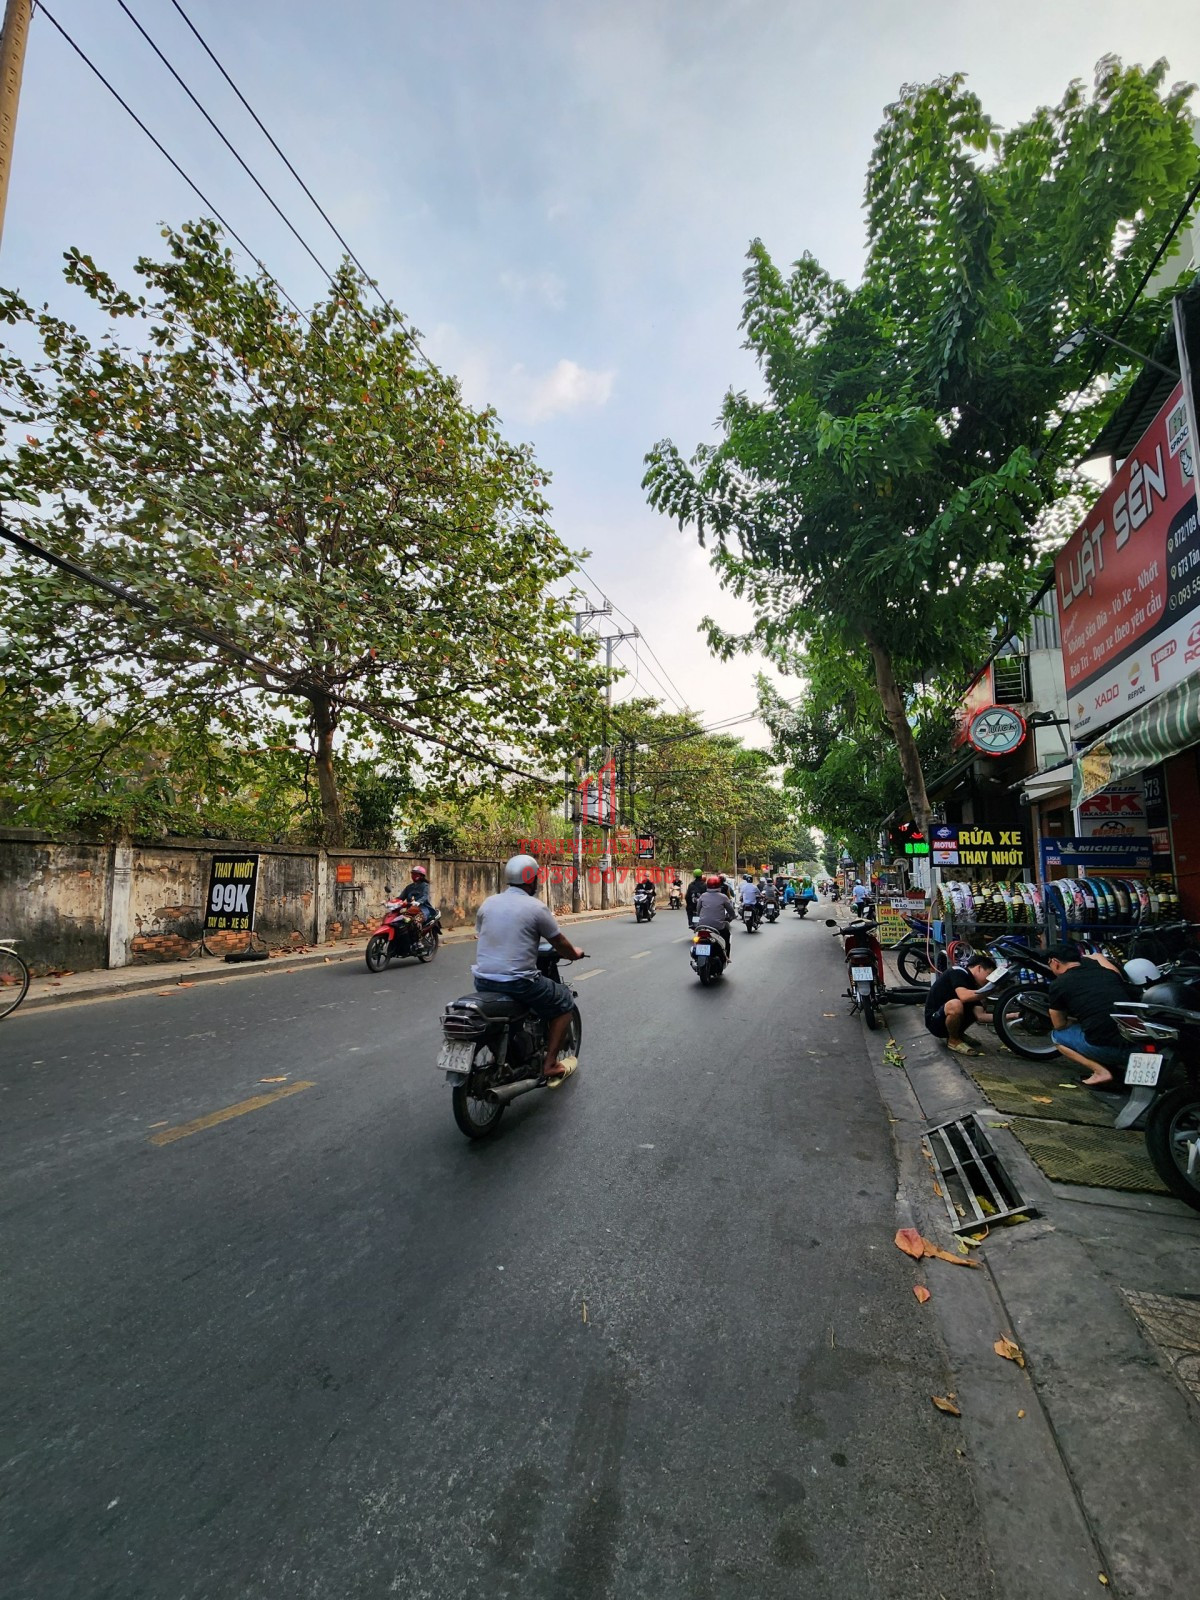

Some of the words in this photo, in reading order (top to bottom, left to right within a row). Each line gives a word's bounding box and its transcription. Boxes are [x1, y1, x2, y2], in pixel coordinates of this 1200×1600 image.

[1060, 519, 1105, 610] LUẬT
[1113, 444, 1167, 551] SÊN
[1178, 556, 1189, 578] 673
[1122, 589, 1132, 608] Xe
[1138, 560, 1158, 592] Nhớt
[1178, 585, 1191, 605] 093
[1106, 635, 1114, 649] xe
[1114, 621, 1129, 643] theo
[1131, 608, 1145, 635] yêu
[1146, 590, 1162, 617] cầu
[1094, 684, 1120, 709] XADO
[1081, 794, 1142, 812] RK
[933, 841, 957, 849] MOTUL
[959, 827, 994, 845] RỬA
[999, 831, 1022, 845] XE
[959, 851, 988, 864] THAY
[992, 848, 1023, 865] NHỚT
[215, 862, 233, 878] THAY
[233, 859, 254, 878] NHỚT
[211, 884, 251, 913] 99K
[207, 917, 217, 927] TAY
[218, 917, 226, 928] GA
[231, 918, 239, 928] XE
[240, 914, 249, 929] SỐ
